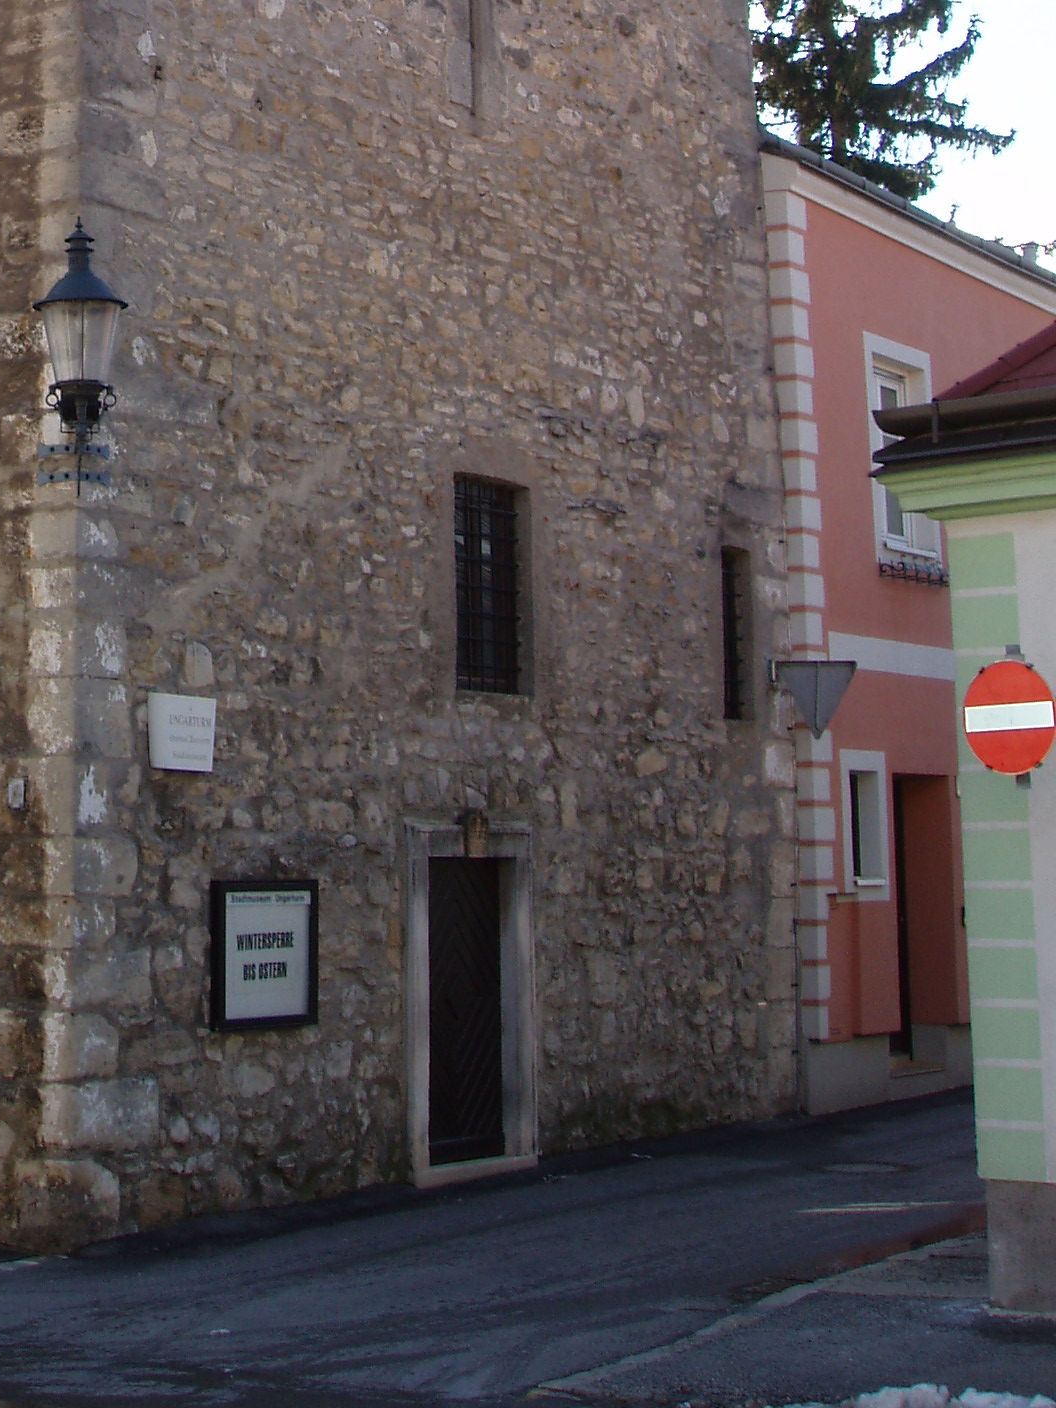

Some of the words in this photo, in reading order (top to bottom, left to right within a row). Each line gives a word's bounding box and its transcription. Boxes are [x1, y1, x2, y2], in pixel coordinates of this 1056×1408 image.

[236, 931, 294, 951] WINTERSPERRE
[243, 963, 256, 981] BIS
[258, 962, 287, 980] OSTERN
